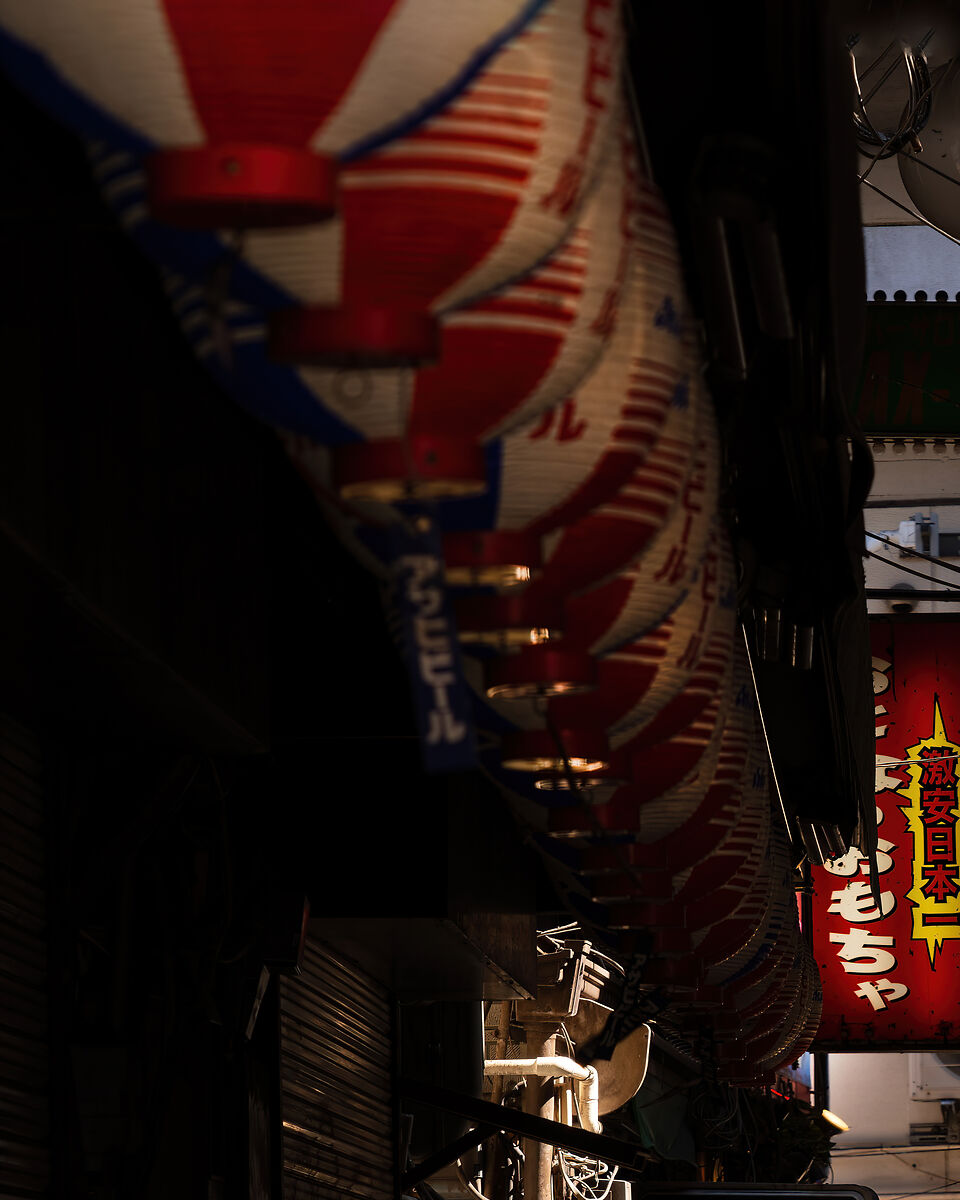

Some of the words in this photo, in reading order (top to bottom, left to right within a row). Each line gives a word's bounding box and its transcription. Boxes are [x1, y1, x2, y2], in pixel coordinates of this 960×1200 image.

[920, 744, 960, 926] 激安日本一
